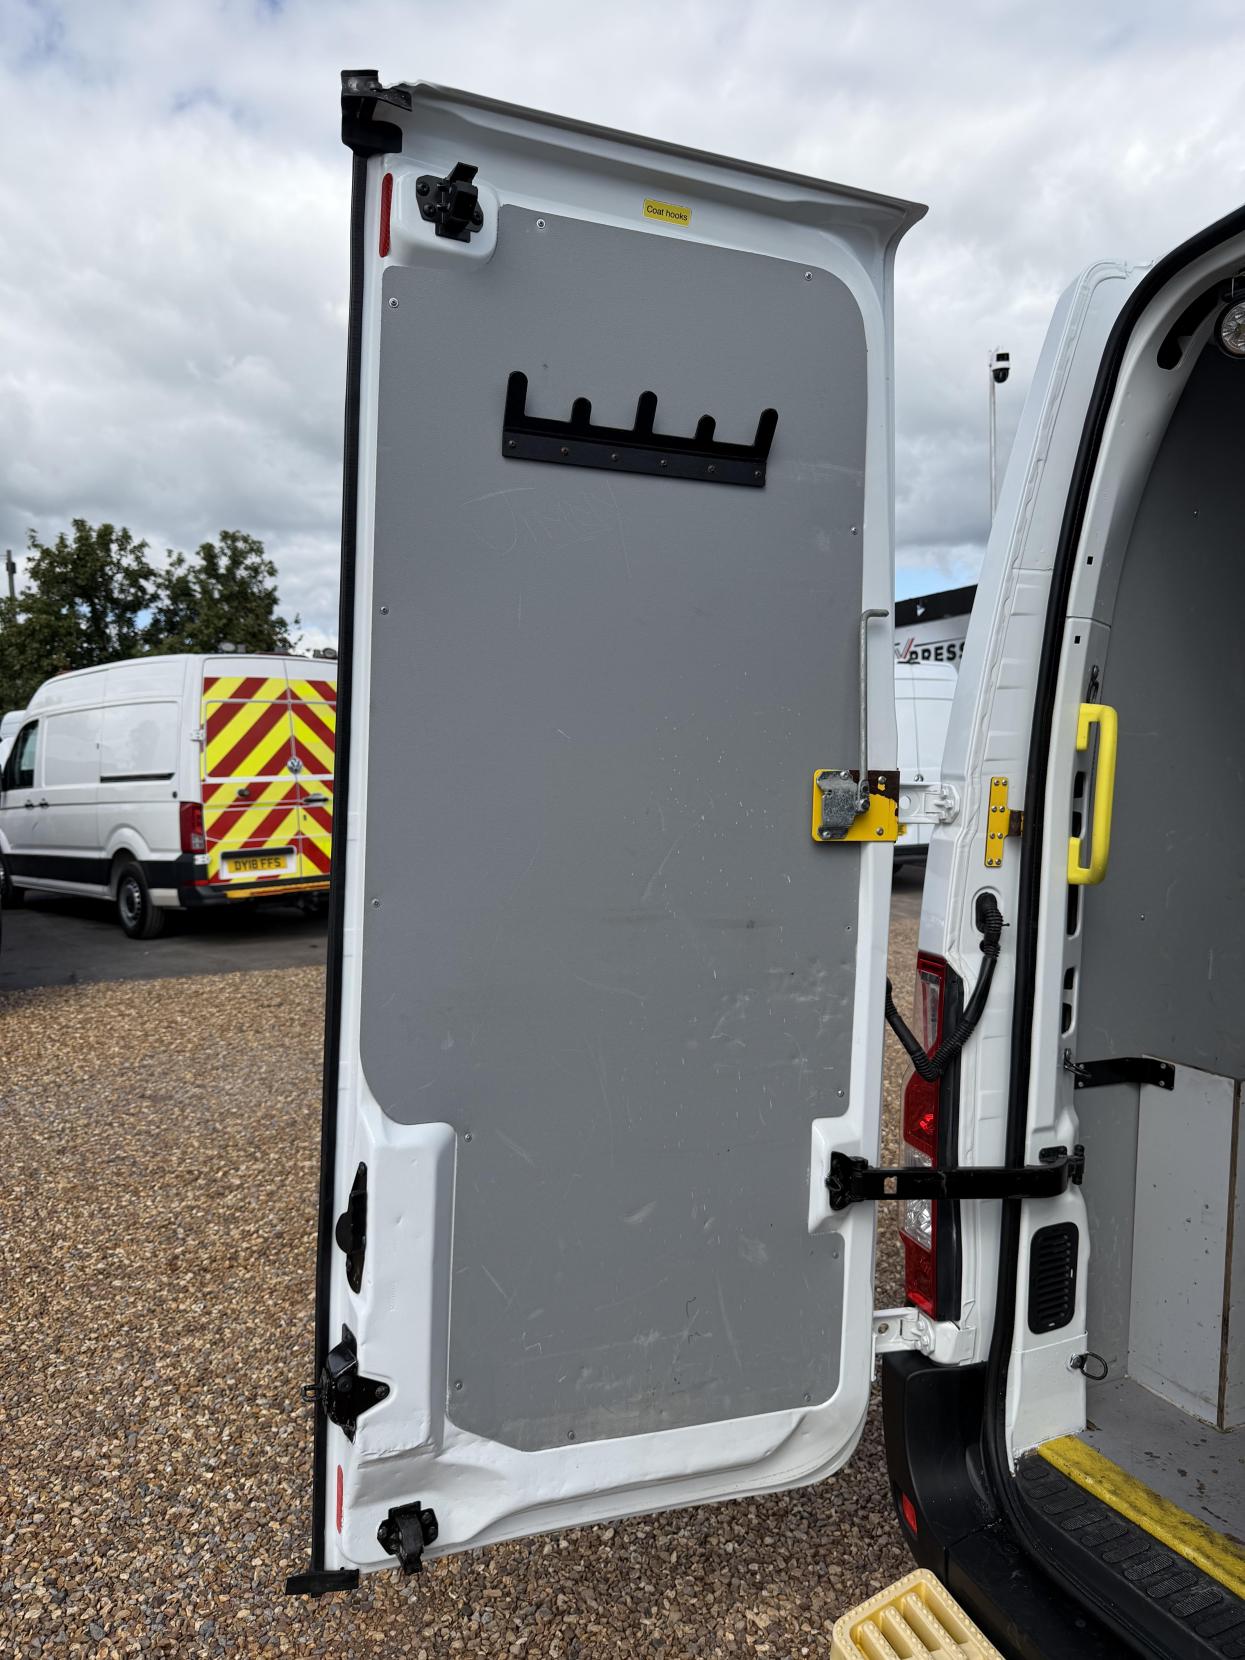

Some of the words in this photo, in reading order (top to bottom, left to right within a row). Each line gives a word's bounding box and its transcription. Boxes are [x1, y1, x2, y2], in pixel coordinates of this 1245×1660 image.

[646, 204, 664, 216] Coat
[665, 209, 688, 221] hooks
[234, 858, 258, 871] DY18
[260, 857, 281, 870] FFS
